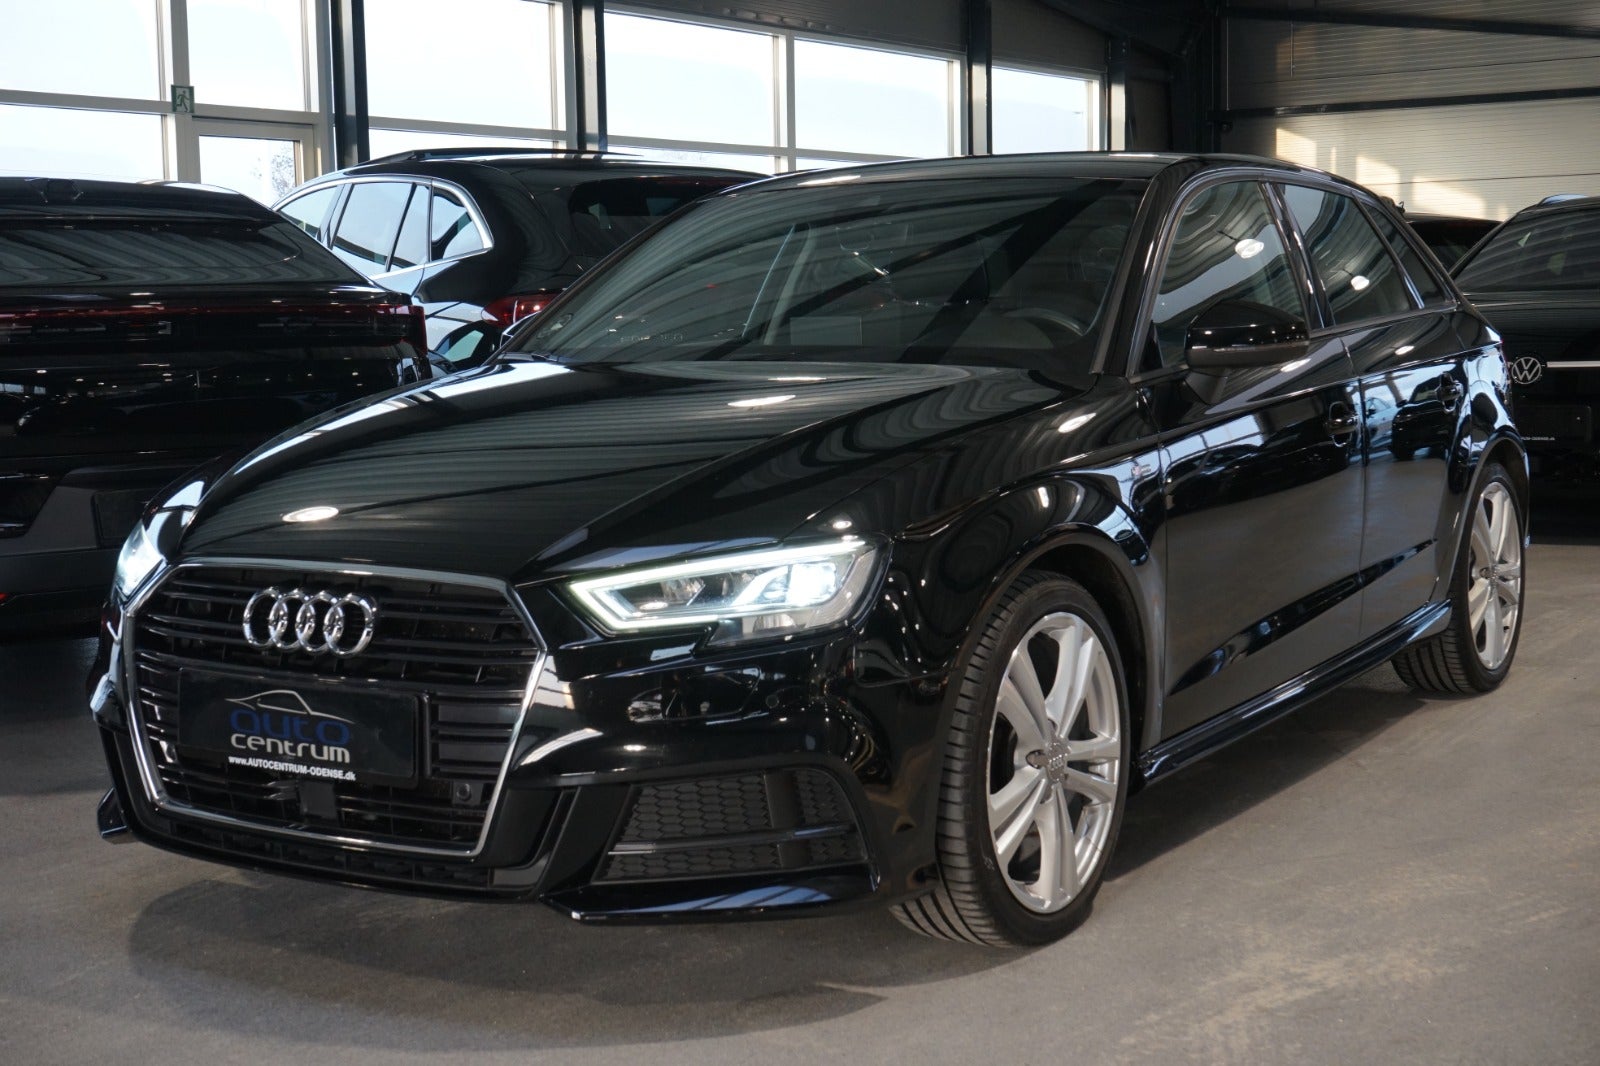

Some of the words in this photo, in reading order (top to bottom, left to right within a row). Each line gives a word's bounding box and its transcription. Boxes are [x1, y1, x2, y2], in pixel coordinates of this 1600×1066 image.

[230, 708, 351, 746] auto
[230, 733, 351, 764] centrum
[228, 756, 356, 781] www.AUTOCENTRUM-ODENSE.dk
